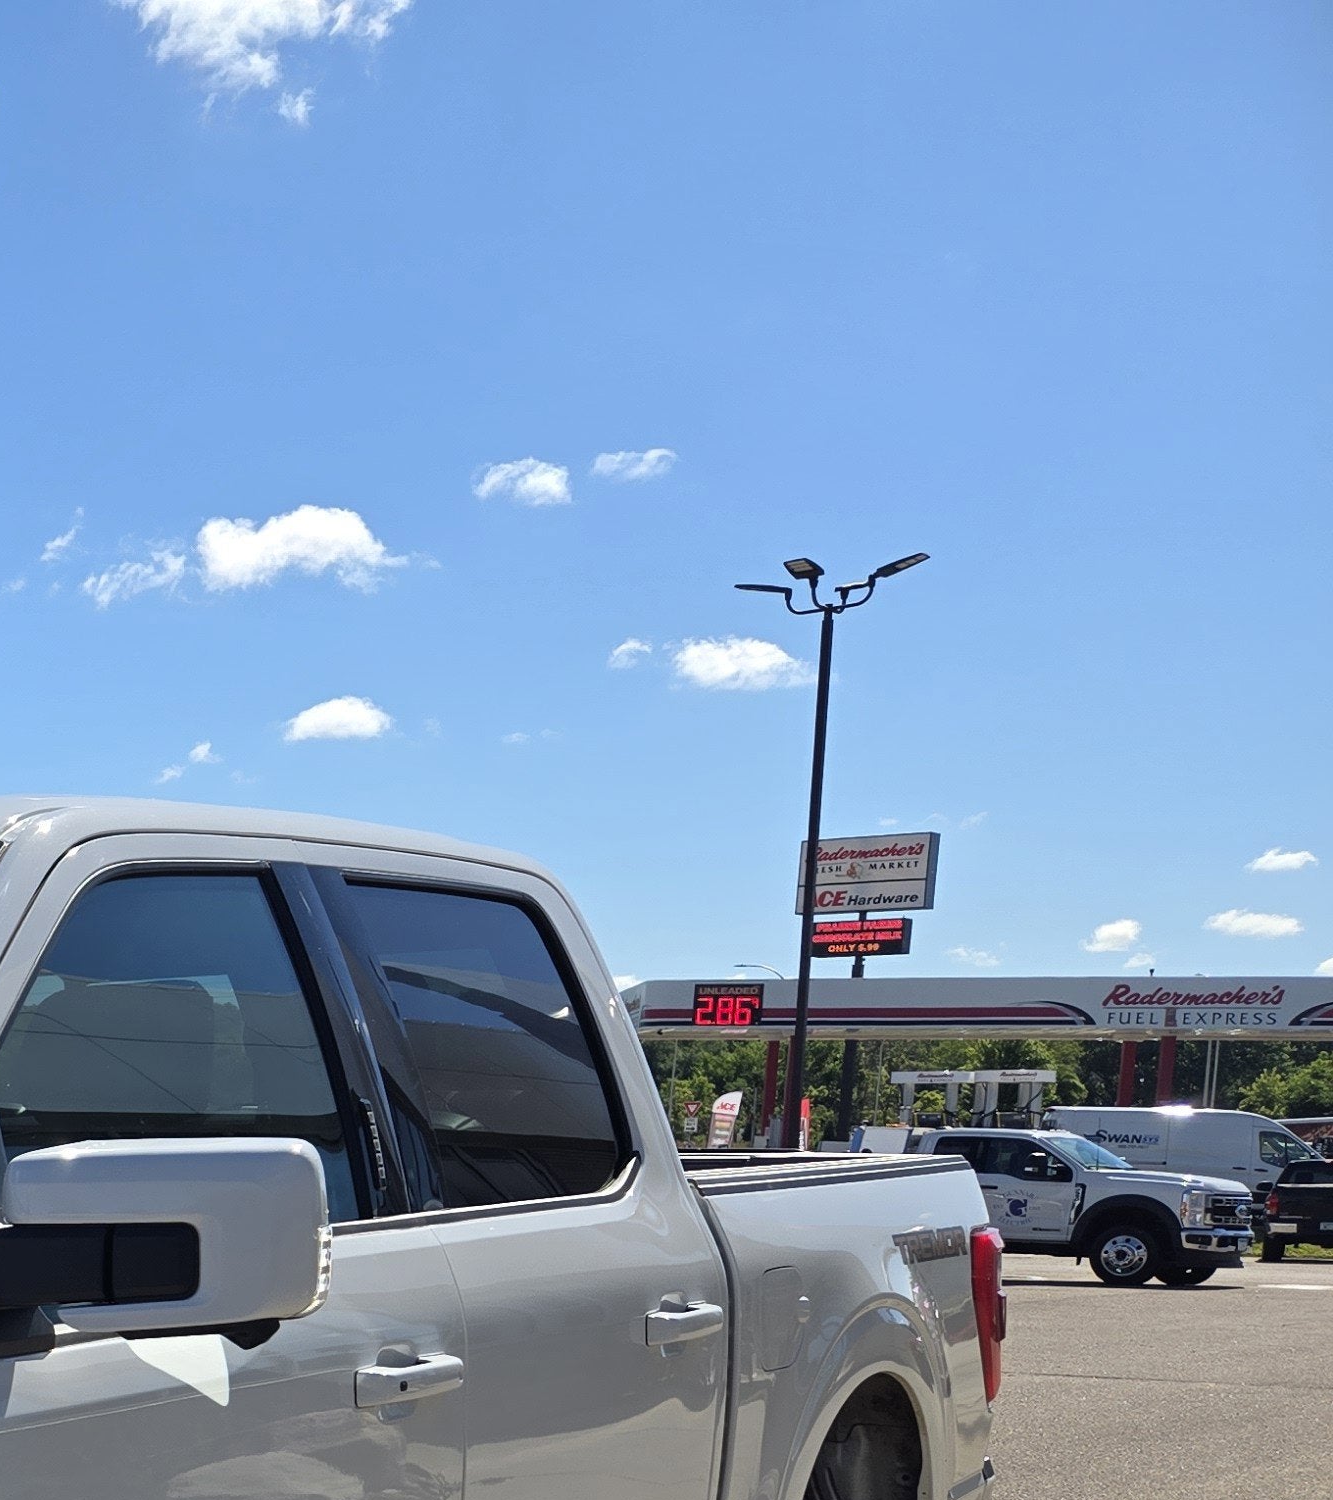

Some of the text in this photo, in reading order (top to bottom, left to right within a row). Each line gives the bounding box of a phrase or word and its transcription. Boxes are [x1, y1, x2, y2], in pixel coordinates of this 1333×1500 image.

[816, 861, 920, 874] ESH MARKET
[814, 890, 919, 908] CE Hardware
[827, 943, 856, 953] ONLY
[699, 987, 759, 995] UNLEADED
[1102, 984, 1286, 1007] Radermacher's
[1107, 1012, 1277, 1025] FUEL EXPRESS
[717, 1102, 737, 1112] ACE
[891, 1225, 968, 1266] TREMOR
